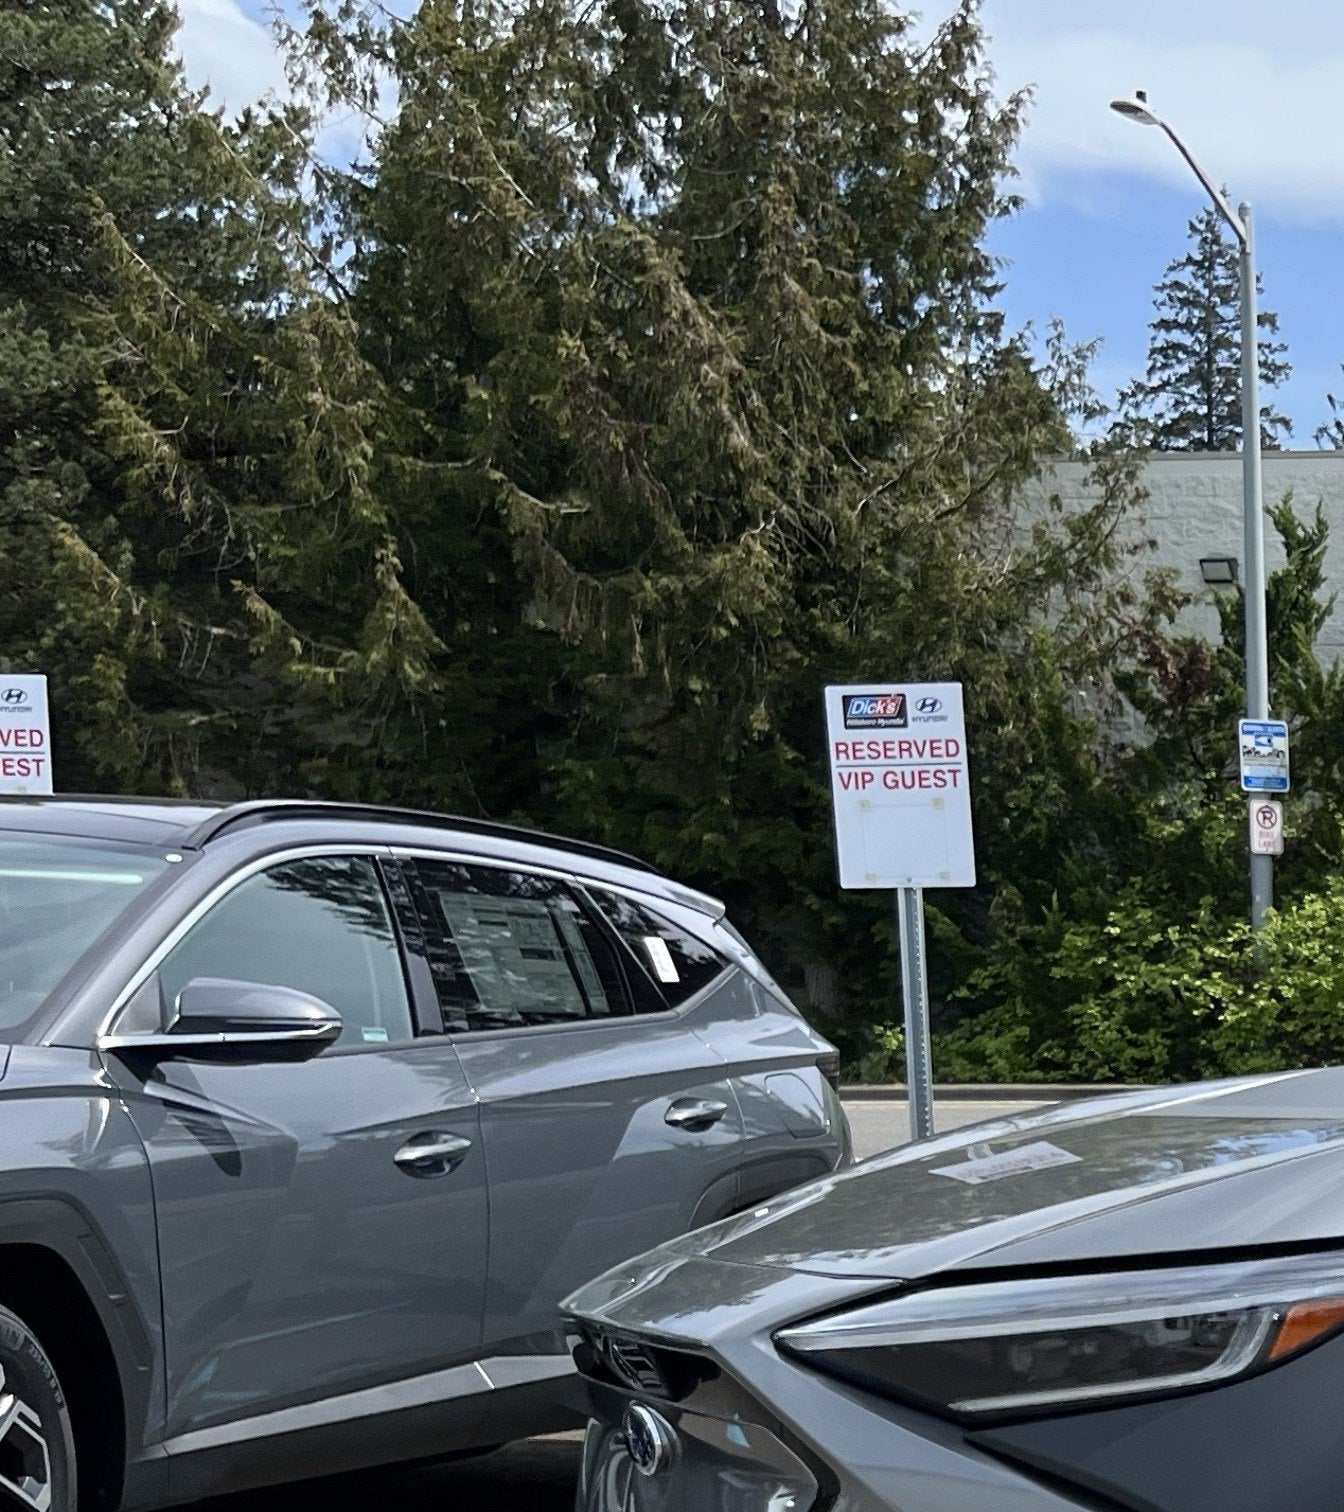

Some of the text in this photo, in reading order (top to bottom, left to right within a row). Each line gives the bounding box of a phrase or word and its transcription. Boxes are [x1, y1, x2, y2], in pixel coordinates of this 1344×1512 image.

[835, 739, 960, 761] RESERVED
[838, 768, 961, 791] VIP GUEST
